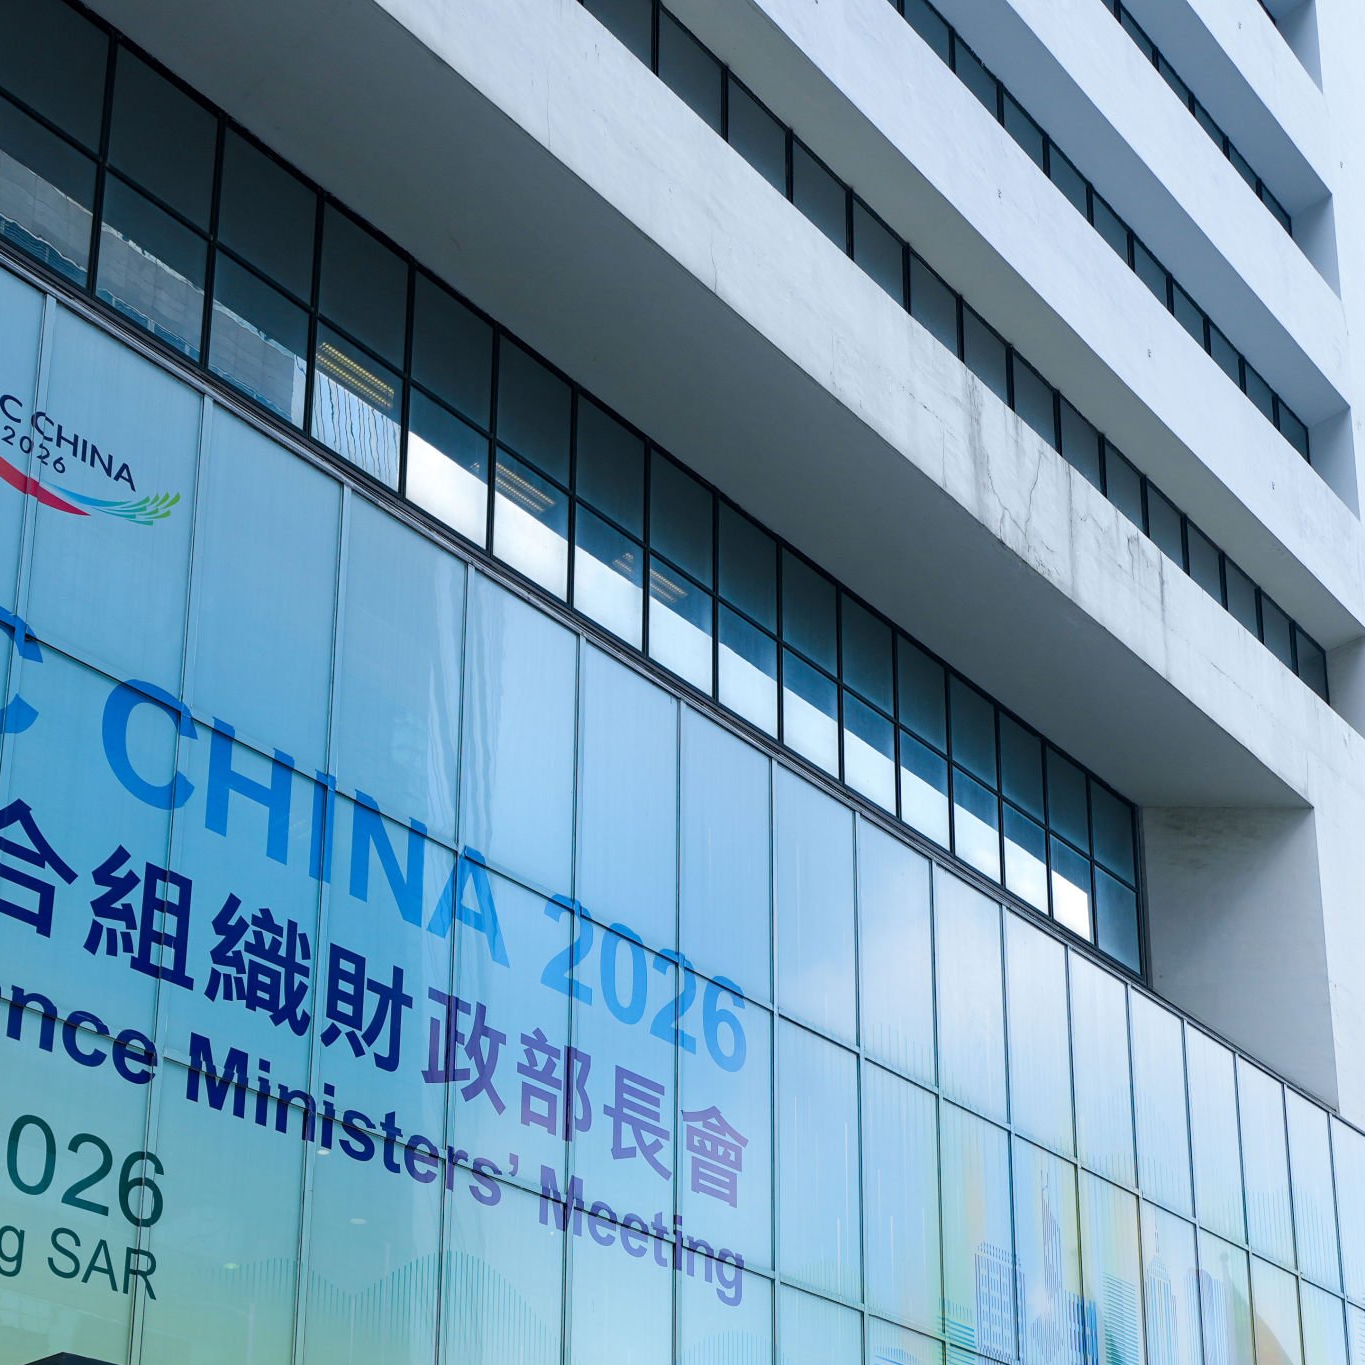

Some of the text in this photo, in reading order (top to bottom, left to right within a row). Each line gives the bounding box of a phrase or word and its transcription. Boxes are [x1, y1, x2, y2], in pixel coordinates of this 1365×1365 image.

[1, 425, 66, 474] 2026
[30, 411, 136, 492] CHINA
[102, 679, 510, 968] CHINA
[540, 895, 747, 1072] 2026
[47, 1227, 157, 1300] SAR
[539, 1164, 745, 1307] Meeting
